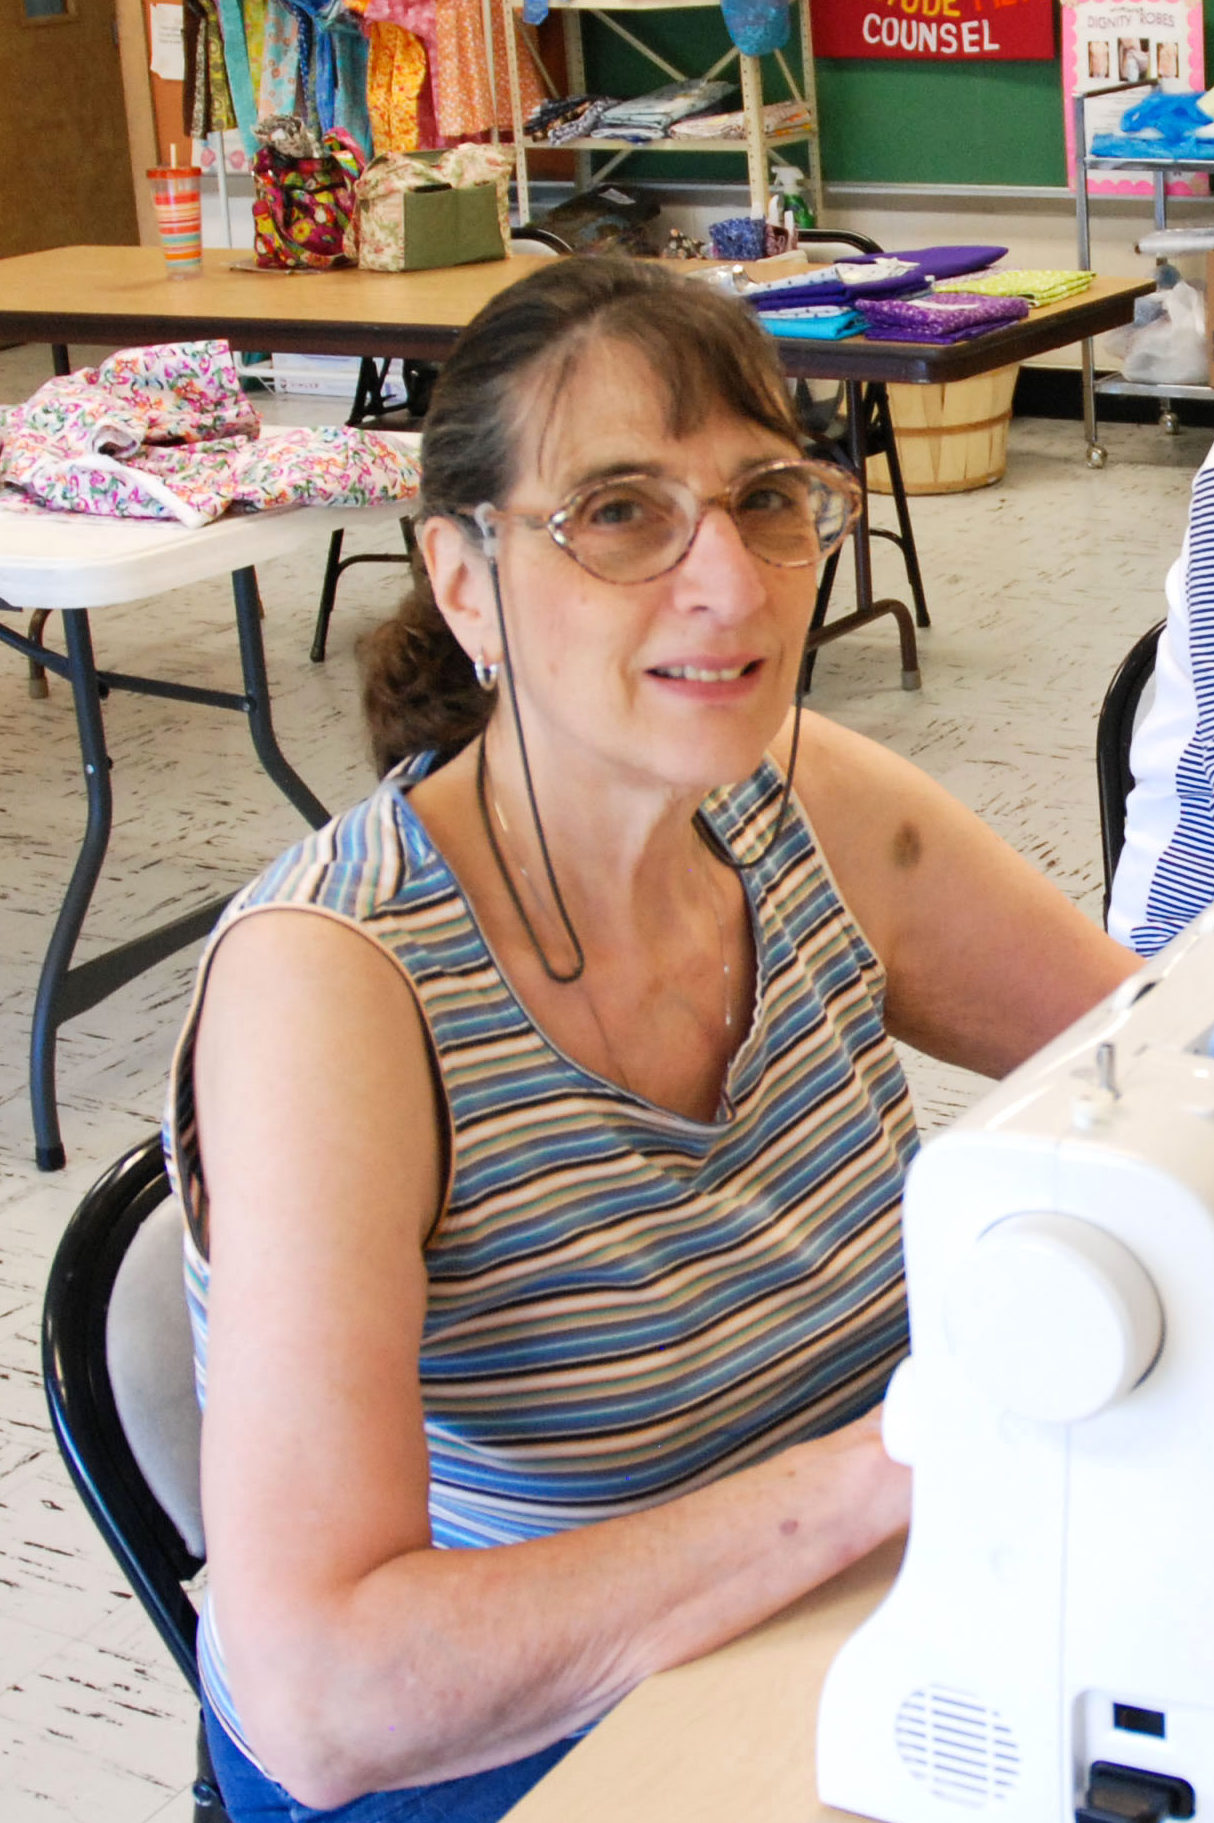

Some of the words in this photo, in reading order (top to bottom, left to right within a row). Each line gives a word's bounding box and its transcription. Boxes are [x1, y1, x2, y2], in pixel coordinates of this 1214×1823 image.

[862, 12, 1000, 54] COUNSEL
[1087, 14, 1132, 30] DIGNITY
[1139, 11, 1175, 28] ROBES
